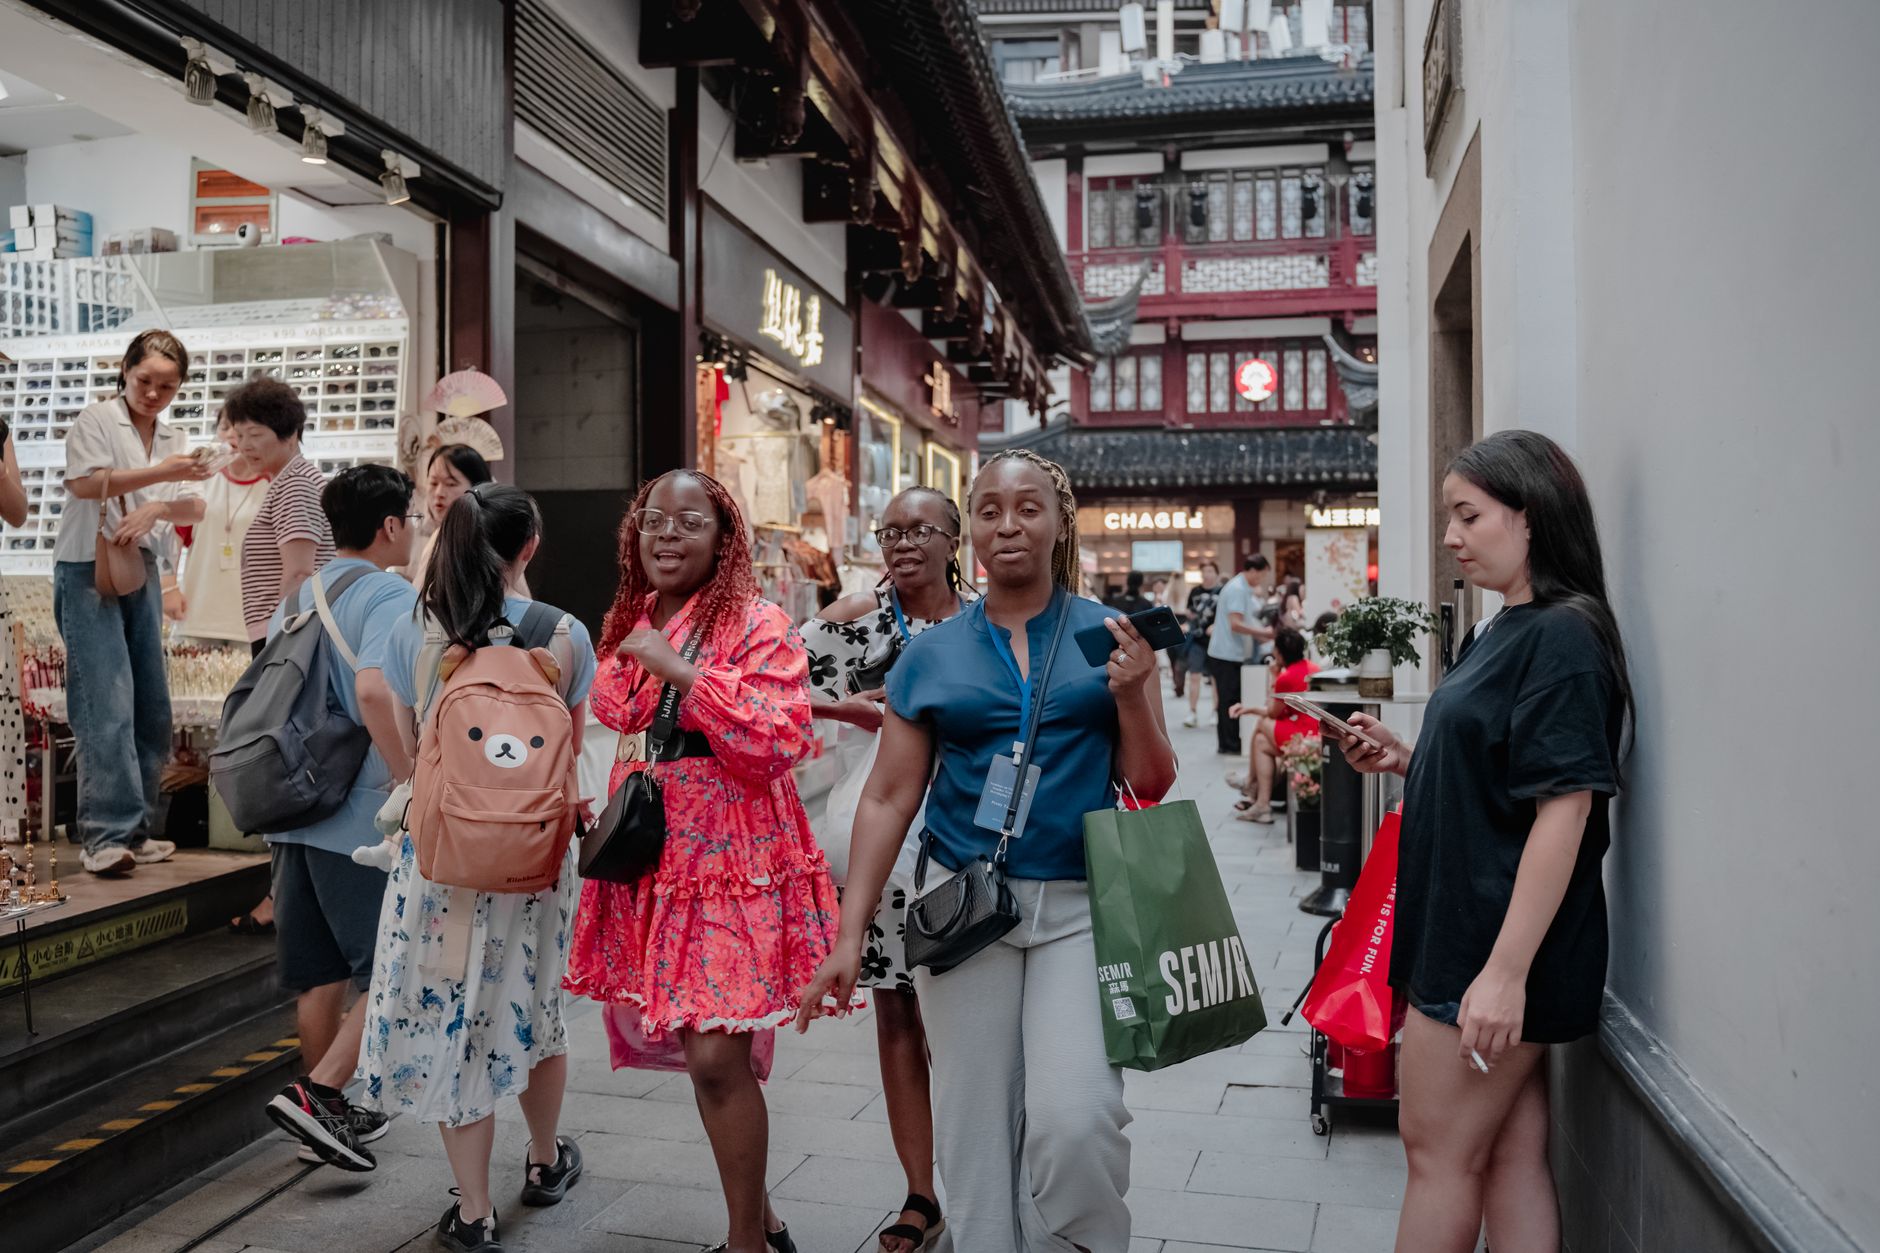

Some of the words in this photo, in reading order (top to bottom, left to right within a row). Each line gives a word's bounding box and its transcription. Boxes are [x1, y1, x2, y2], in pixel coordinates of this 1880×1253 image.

[1380, 903, 1392, 917] IS
[1369, 919, 1388, 945] FOR
[1098, 962, 1133, 983] SEMIR
[1359, 947, 1378, 975] FUN.
[1159, 935, 1254, 1016] SEMIR
